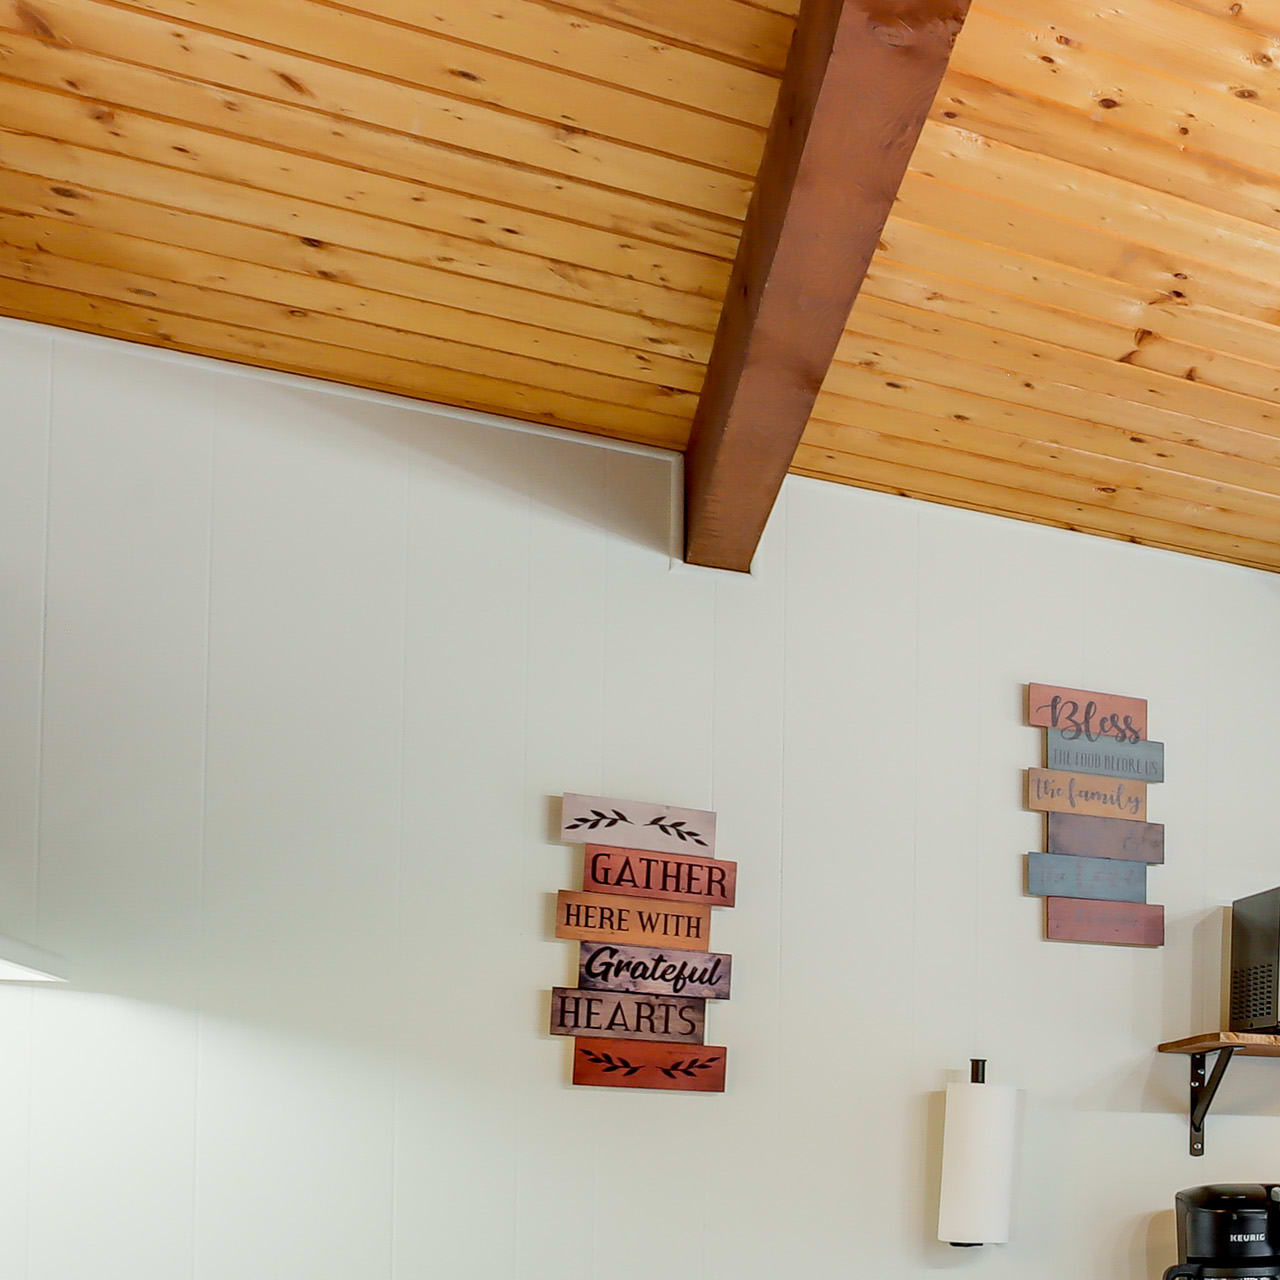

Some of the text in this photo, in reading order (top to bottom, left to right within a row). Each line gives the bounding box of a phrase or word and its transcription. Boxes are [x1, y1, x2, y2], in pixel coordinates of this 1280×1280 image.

[1036, 695, 1143, 744] Bless
[1067, 777, 1144, 815] family
[591, 852, 728, 899] GATHER
[565, 903, 703, 939] HERE WITH
[584, 945, 723, 994] Grateful
[557, 995, 697, 1036] HEARTS
[1230, 1233, 1266, 1242] KEURIG
